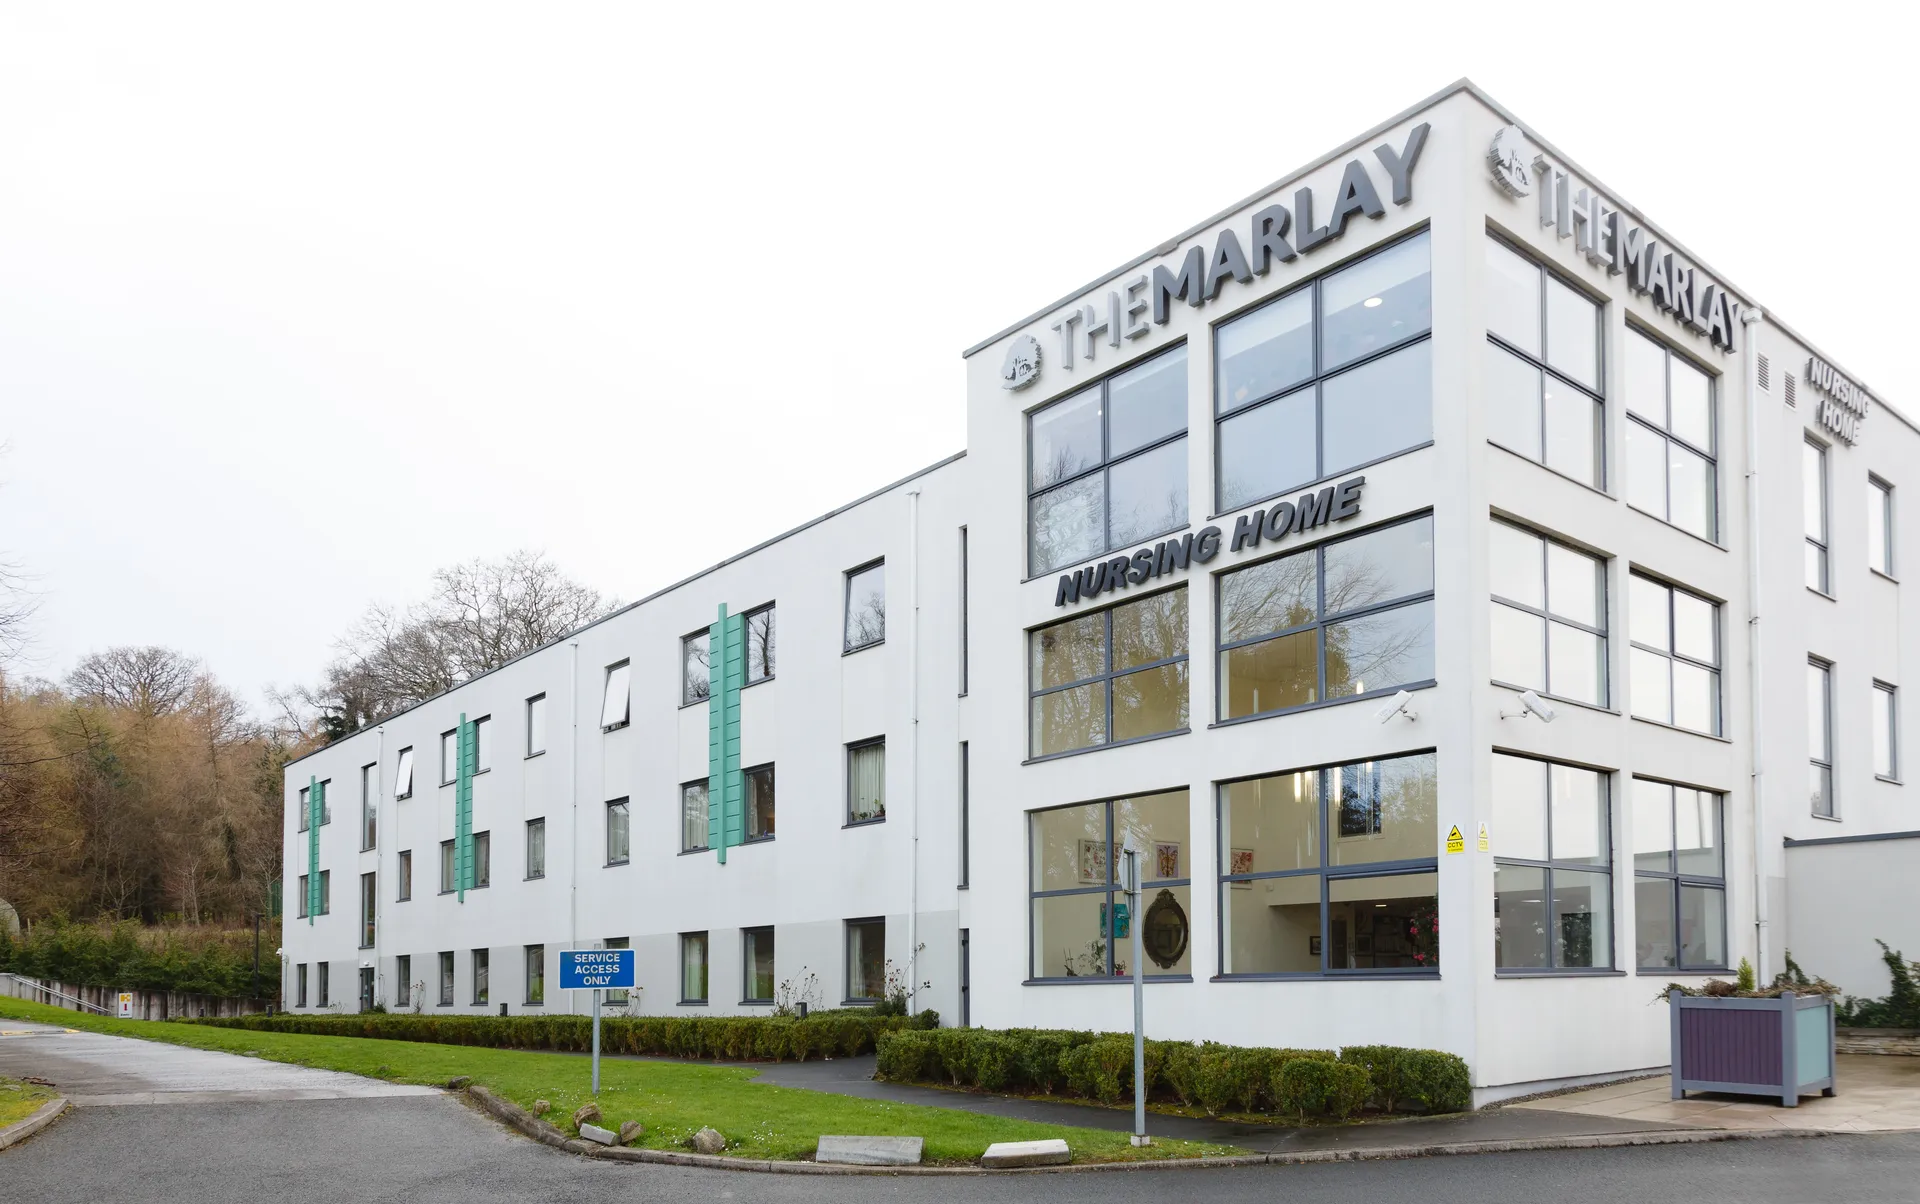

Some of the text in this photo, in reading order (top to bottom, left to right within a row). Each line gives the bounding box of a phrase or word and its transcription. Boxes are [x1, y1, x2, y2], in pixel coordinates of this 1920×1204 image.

[1808, 356, 1869, 419] NURSING
[1820, 399, 1860, 446] HOME
[1055, 476, 1366, 607] NURSING HOME
[574, 953, 620, 963] SERVICE
[574, 964, 620, 974] ACCESS
[583, 976, 611, 985] ONLY
